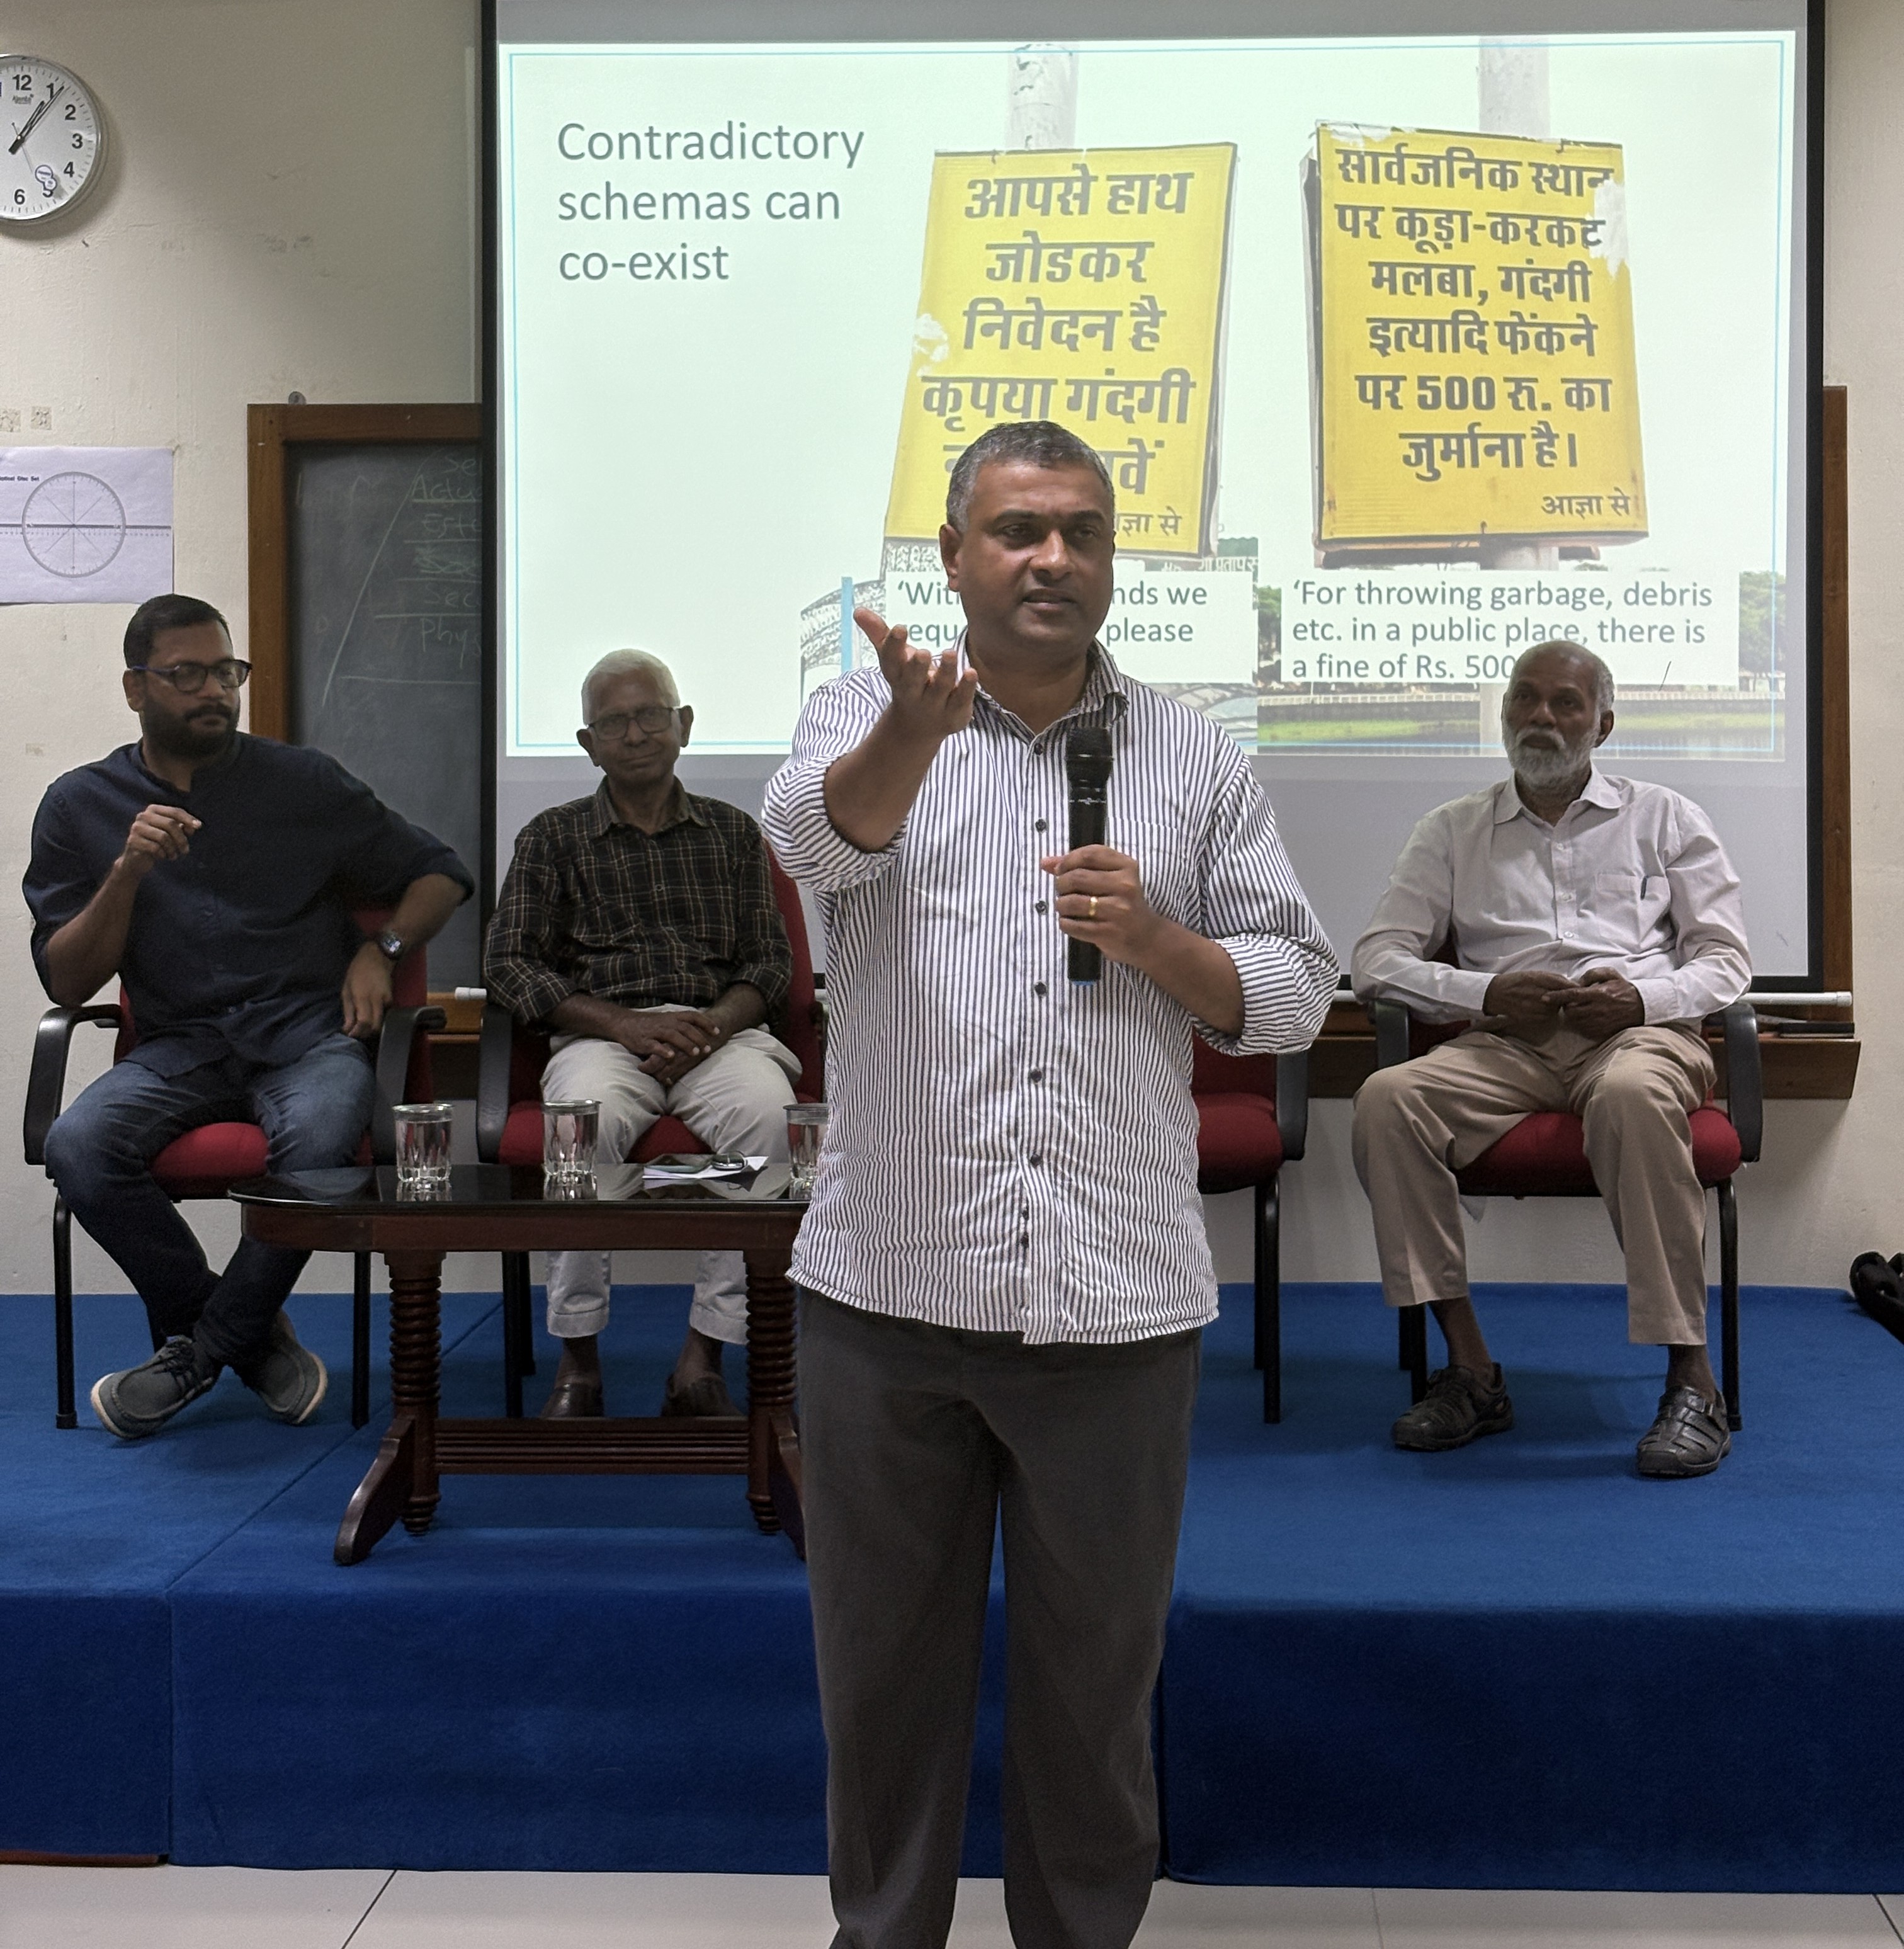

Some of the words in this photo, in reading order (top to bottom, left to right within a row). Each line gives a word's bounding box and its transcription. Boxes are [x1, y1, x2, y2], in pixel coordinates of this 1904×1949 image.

[13, 74, 31, 91] 12
[65, 104, 76, 120] 2
[72, 133, 83, 149] 3
[558, 120, 864, 169] Contradictory
[64, 161, 74, 178] 4
[1335, 143, 1522, 191] सार्वजनिक
[14, 189, 25, 205] 6
[558, 181, 750, 220] schemas
[766, 191, 840, 220] can
[965, 164, 1098, 219] आपसे
[1106, 173, 1194, 214] हाथ
[1335, 204, 1385, 239] पर
[560, 242, 729, 280] co-exist
[986, 230, 1155, 283] जोडकर
[1369, 259, 1489, 306] मलबा,
[1498, 258, 1592, 302] गंदगी
[963, 297, 1123, 351] निवेदन
[1130, 295, 1166, 351] है
[1366, 310, 1489, 358] इत्यादि
[1494, 310, 1597, 356] फेंकने
[921, 375, 1058, 432] कृपया
[1065, 368, 1196, 423] गंदगी
[1355, 375, 1407, 411] पर
[1417, 375, 1495, 411] 500
[1503, 377, 1551, 411] रु.
[1561, 378, 1612, 412] का
[1399, 422, 1526, 482] जुर्माना
[1116, 513, 1153, 536] ज्ञा
[1158, 506, 1182, 535] से
[1541, 495, 1602, 520] आज्ञा
[1608, 487, 1631, 516] से
[898, 581, 960, 605] ‘Wit
[1113, 581, 1158, 605] nds
[1167, 586, 1207, 605] we
[1293, 580, 1347, 605] ‘For
[1356, 580, 1482, 610] throwing
[1490, 581, 1612, 610] garbage,
[1623, 581, 1712, 606] debris
[1106, 617, 1193, 647] please
[1292, 619, 1343, 642] etc.
[1352, 617, 1376, 642] in
[1386, 624, 1400, 642] a
[1412, 617, 1496, 647] public
[1505, 617, 1587, 648] place,
[1597, 617, 1675, 644] there
[1686, 618, 1705, 644] is
[1292, 660, 1306, 678] a
[1317, 652, 1369, 678] fine
[1378, 653, 1407, 678] of
[1416, 656, 1454, 679] Rs.
